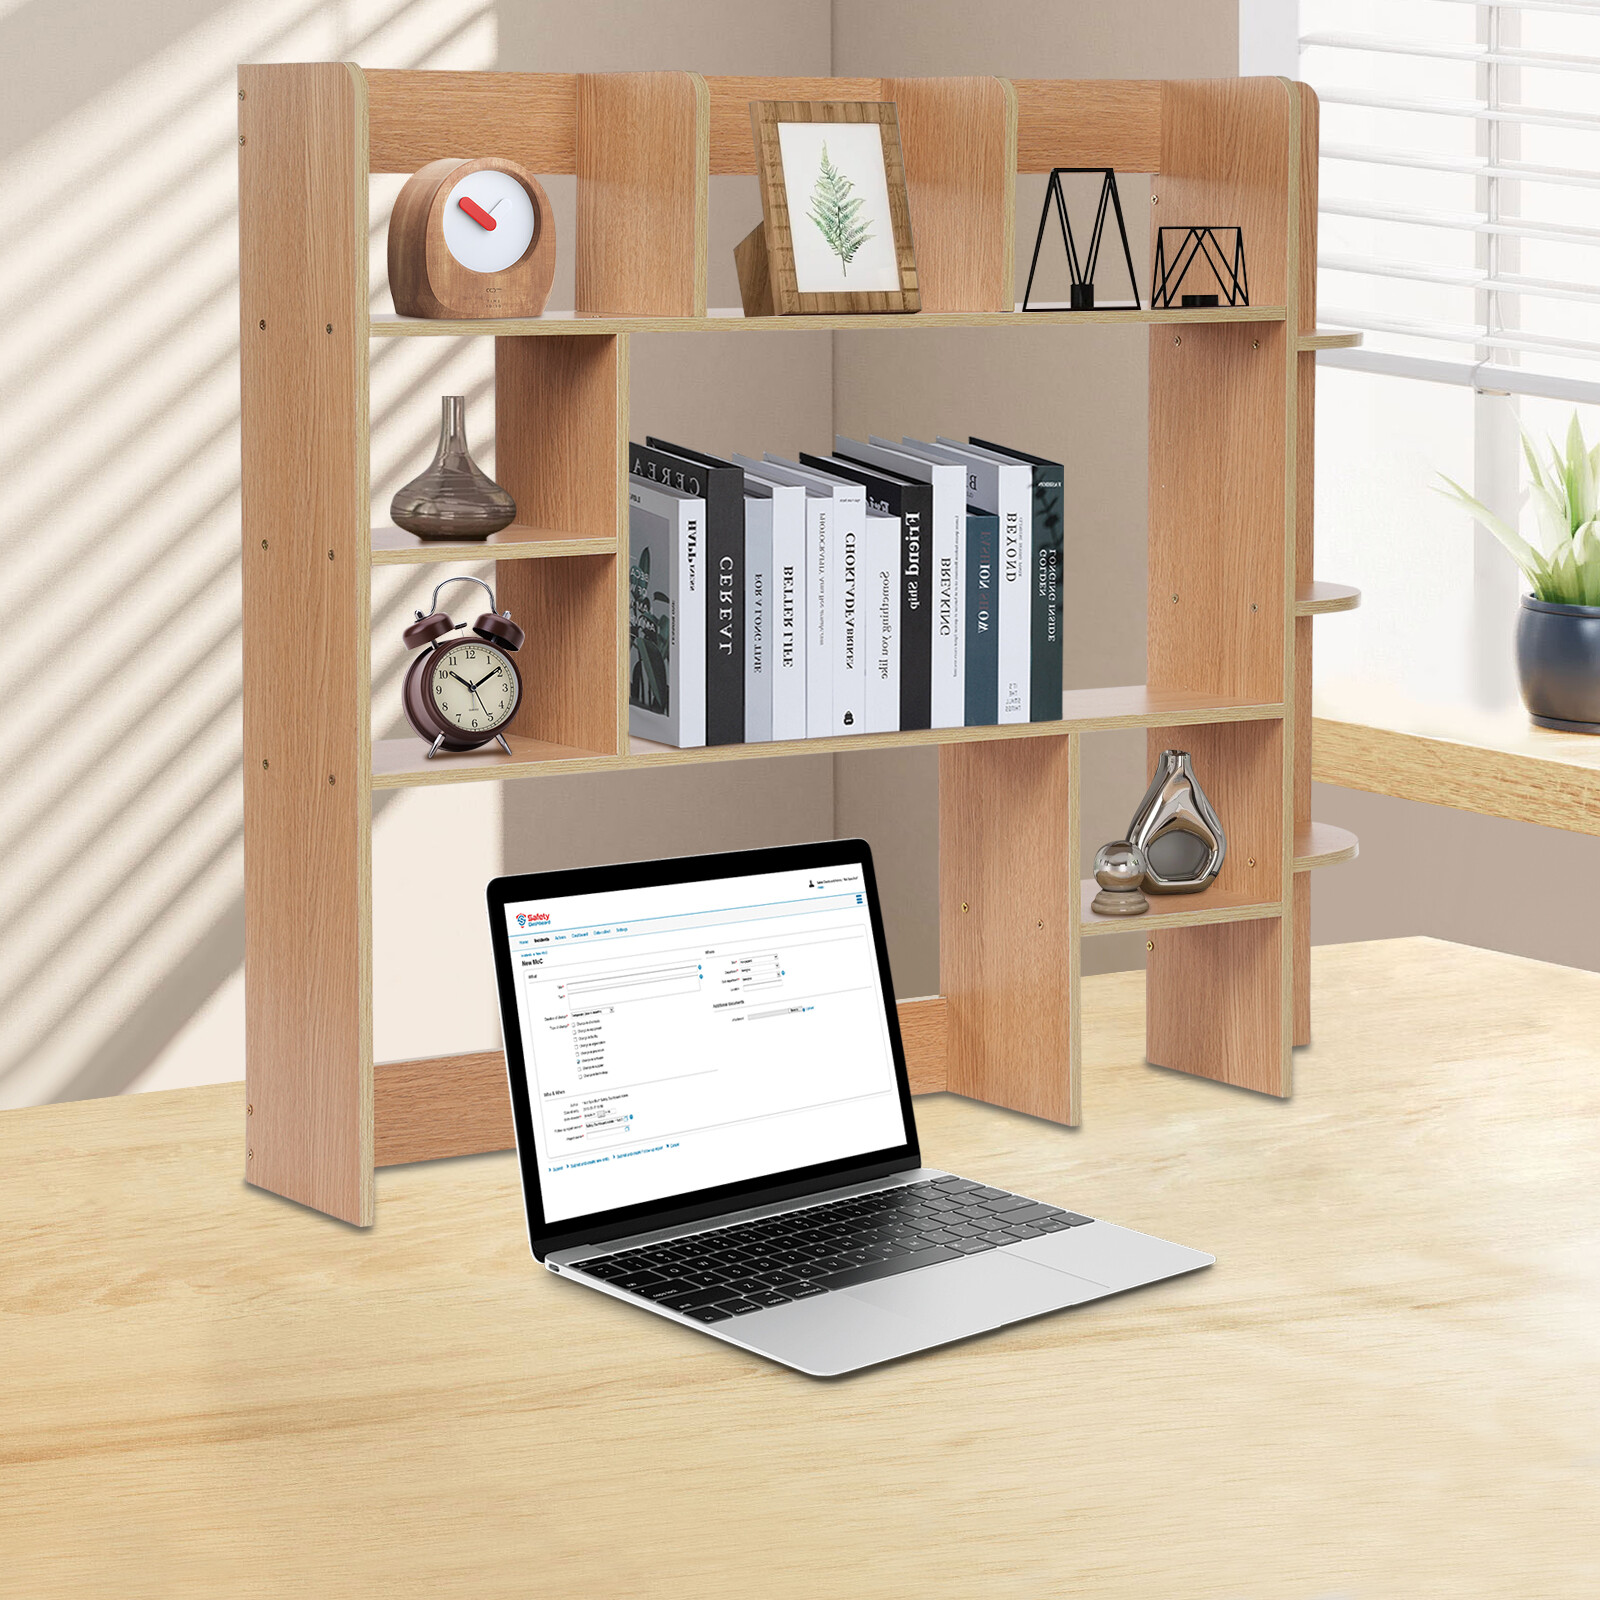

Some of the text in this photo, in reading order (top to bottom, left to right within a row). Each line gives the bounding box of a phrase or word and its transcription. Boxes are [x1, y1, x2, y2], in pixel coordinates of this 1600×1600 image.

[465, 650, 476, 659] 12
[449, 657, 457, 665] 11
[487, 656, 491, 664] 1
[438, 670, 448, 679] 10
[436, 686, 442, 694] 9
[502, 683, 508, 692] 3
[442, 702, 448, 711] 8
[499, 700, 504, 709] 4
[456, 714, 462, 722] 7
[488, 712, 494, 722] 5
[472, 719, 478, 728] 6
[528, 913, 550, 922] Safety
